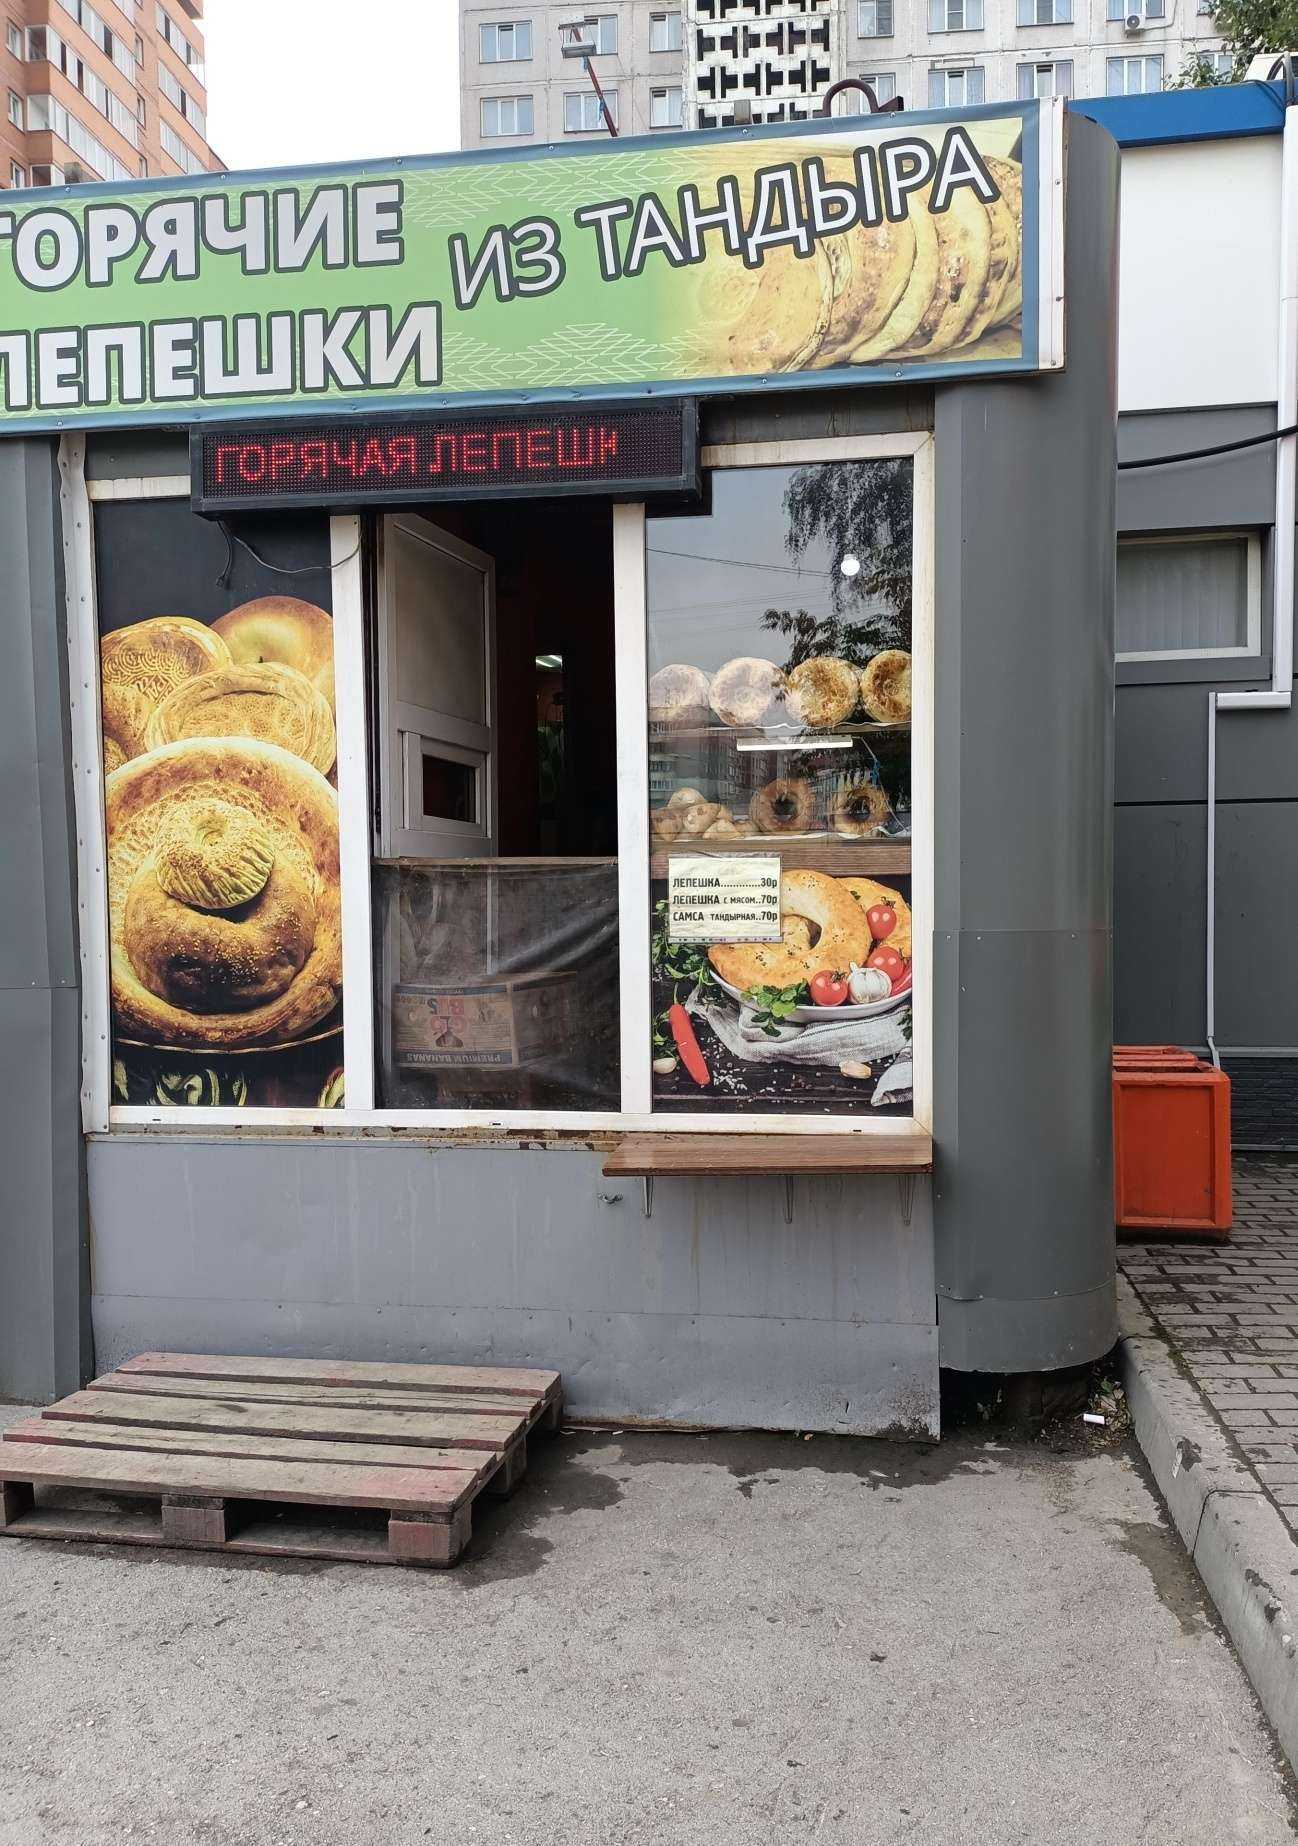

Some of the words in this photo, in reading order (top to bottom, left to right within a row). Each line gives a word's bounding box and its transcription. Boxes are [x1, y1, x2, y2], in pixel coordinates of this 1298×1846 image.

[448, 215, 567, 310] ИЗ
[574, 126, 1000, 281] ТАНДЫРА
[0, 180, 404, 292] ОРЯЧИЕ
[215, 436, 416, 482] ГОРЯЧАЯ
[672, 878, 720, 888] ЛЕПЕШКА
[672, 895, 720, 905] ЛЕПЕШКА
[673, 911, 704, 921] САМСА
